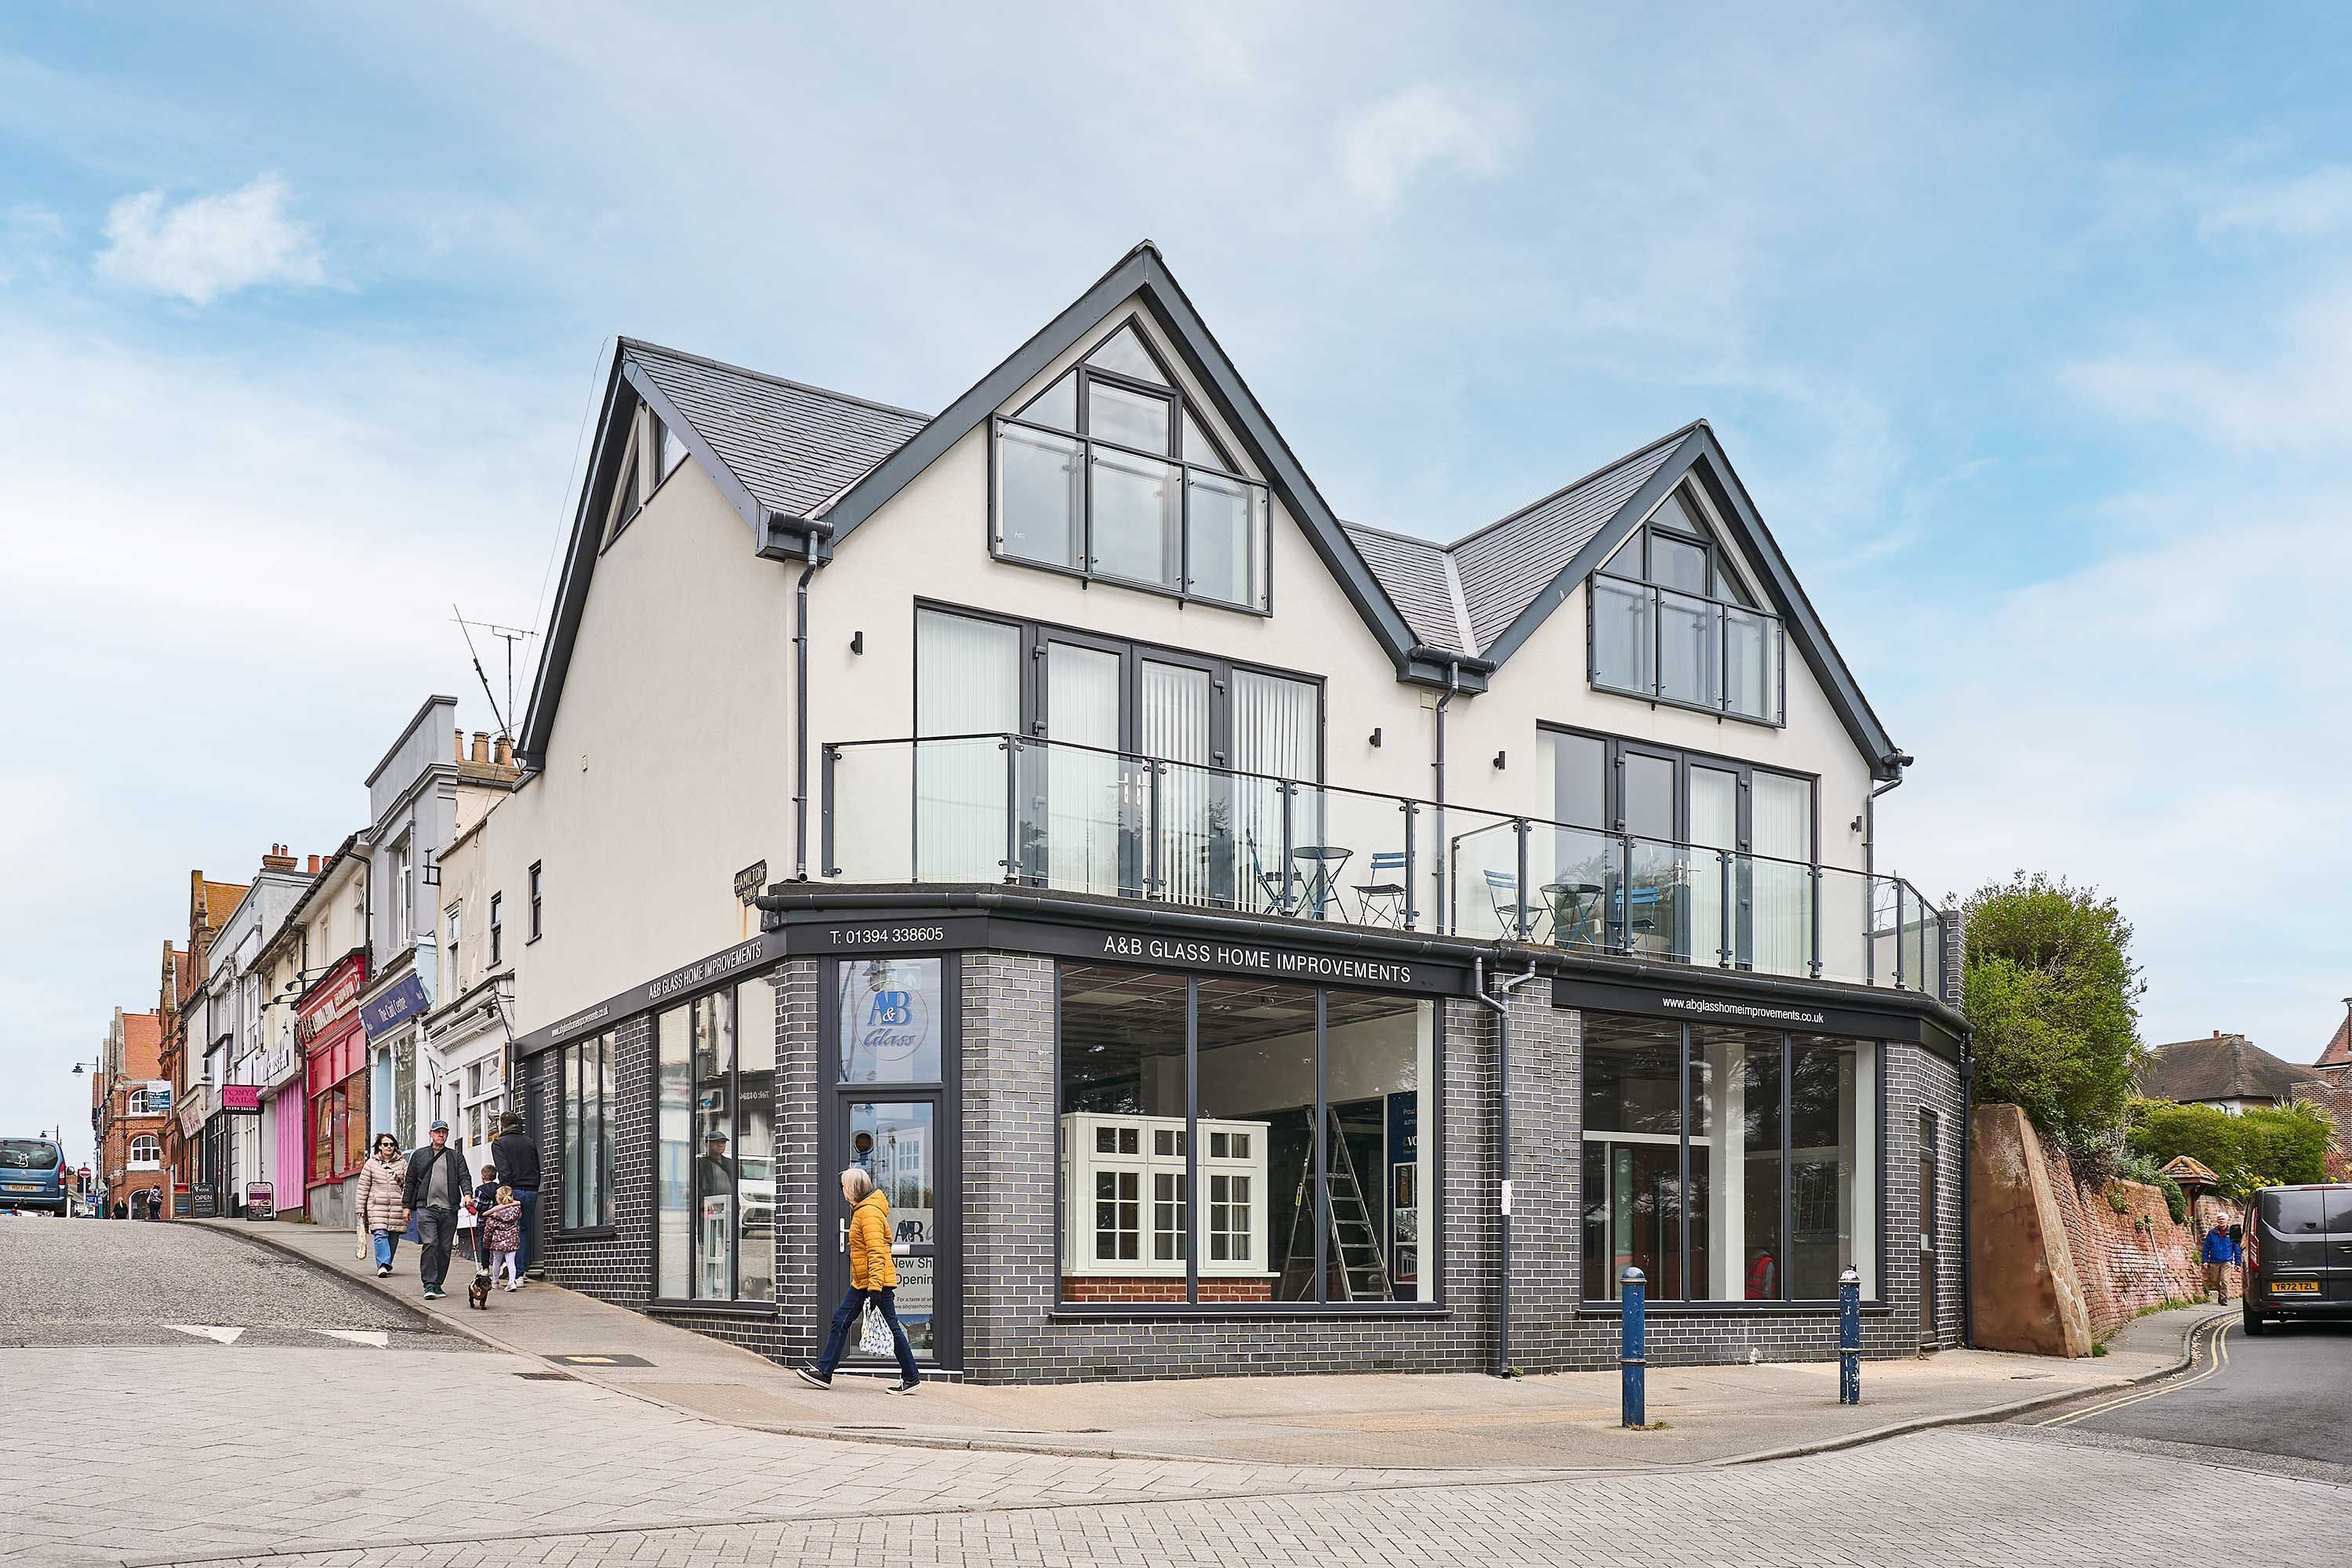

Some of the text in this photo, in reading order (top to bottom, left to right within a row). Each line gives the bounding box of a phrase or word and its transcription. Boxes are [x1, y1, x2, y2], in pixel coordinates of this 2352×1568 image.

[735, 864, 764, 892] HAMILTON
[743, 885, 757, 902] ROAD
[829, 927, 944, 944] T: 01394 338605
[648, 941, 762, 1000] A&B GLASS HOME IMPROVEMENTS
[1103, 935, 1411, 983] A&B GLASS HOME IMPROVEMENTS
[867, 989, 913, 1026] A&B
[1662, 997, 1824, 1024] www.abglasshomeimprovements.co.uk
[864, 1028, 916, 1047] Glass
